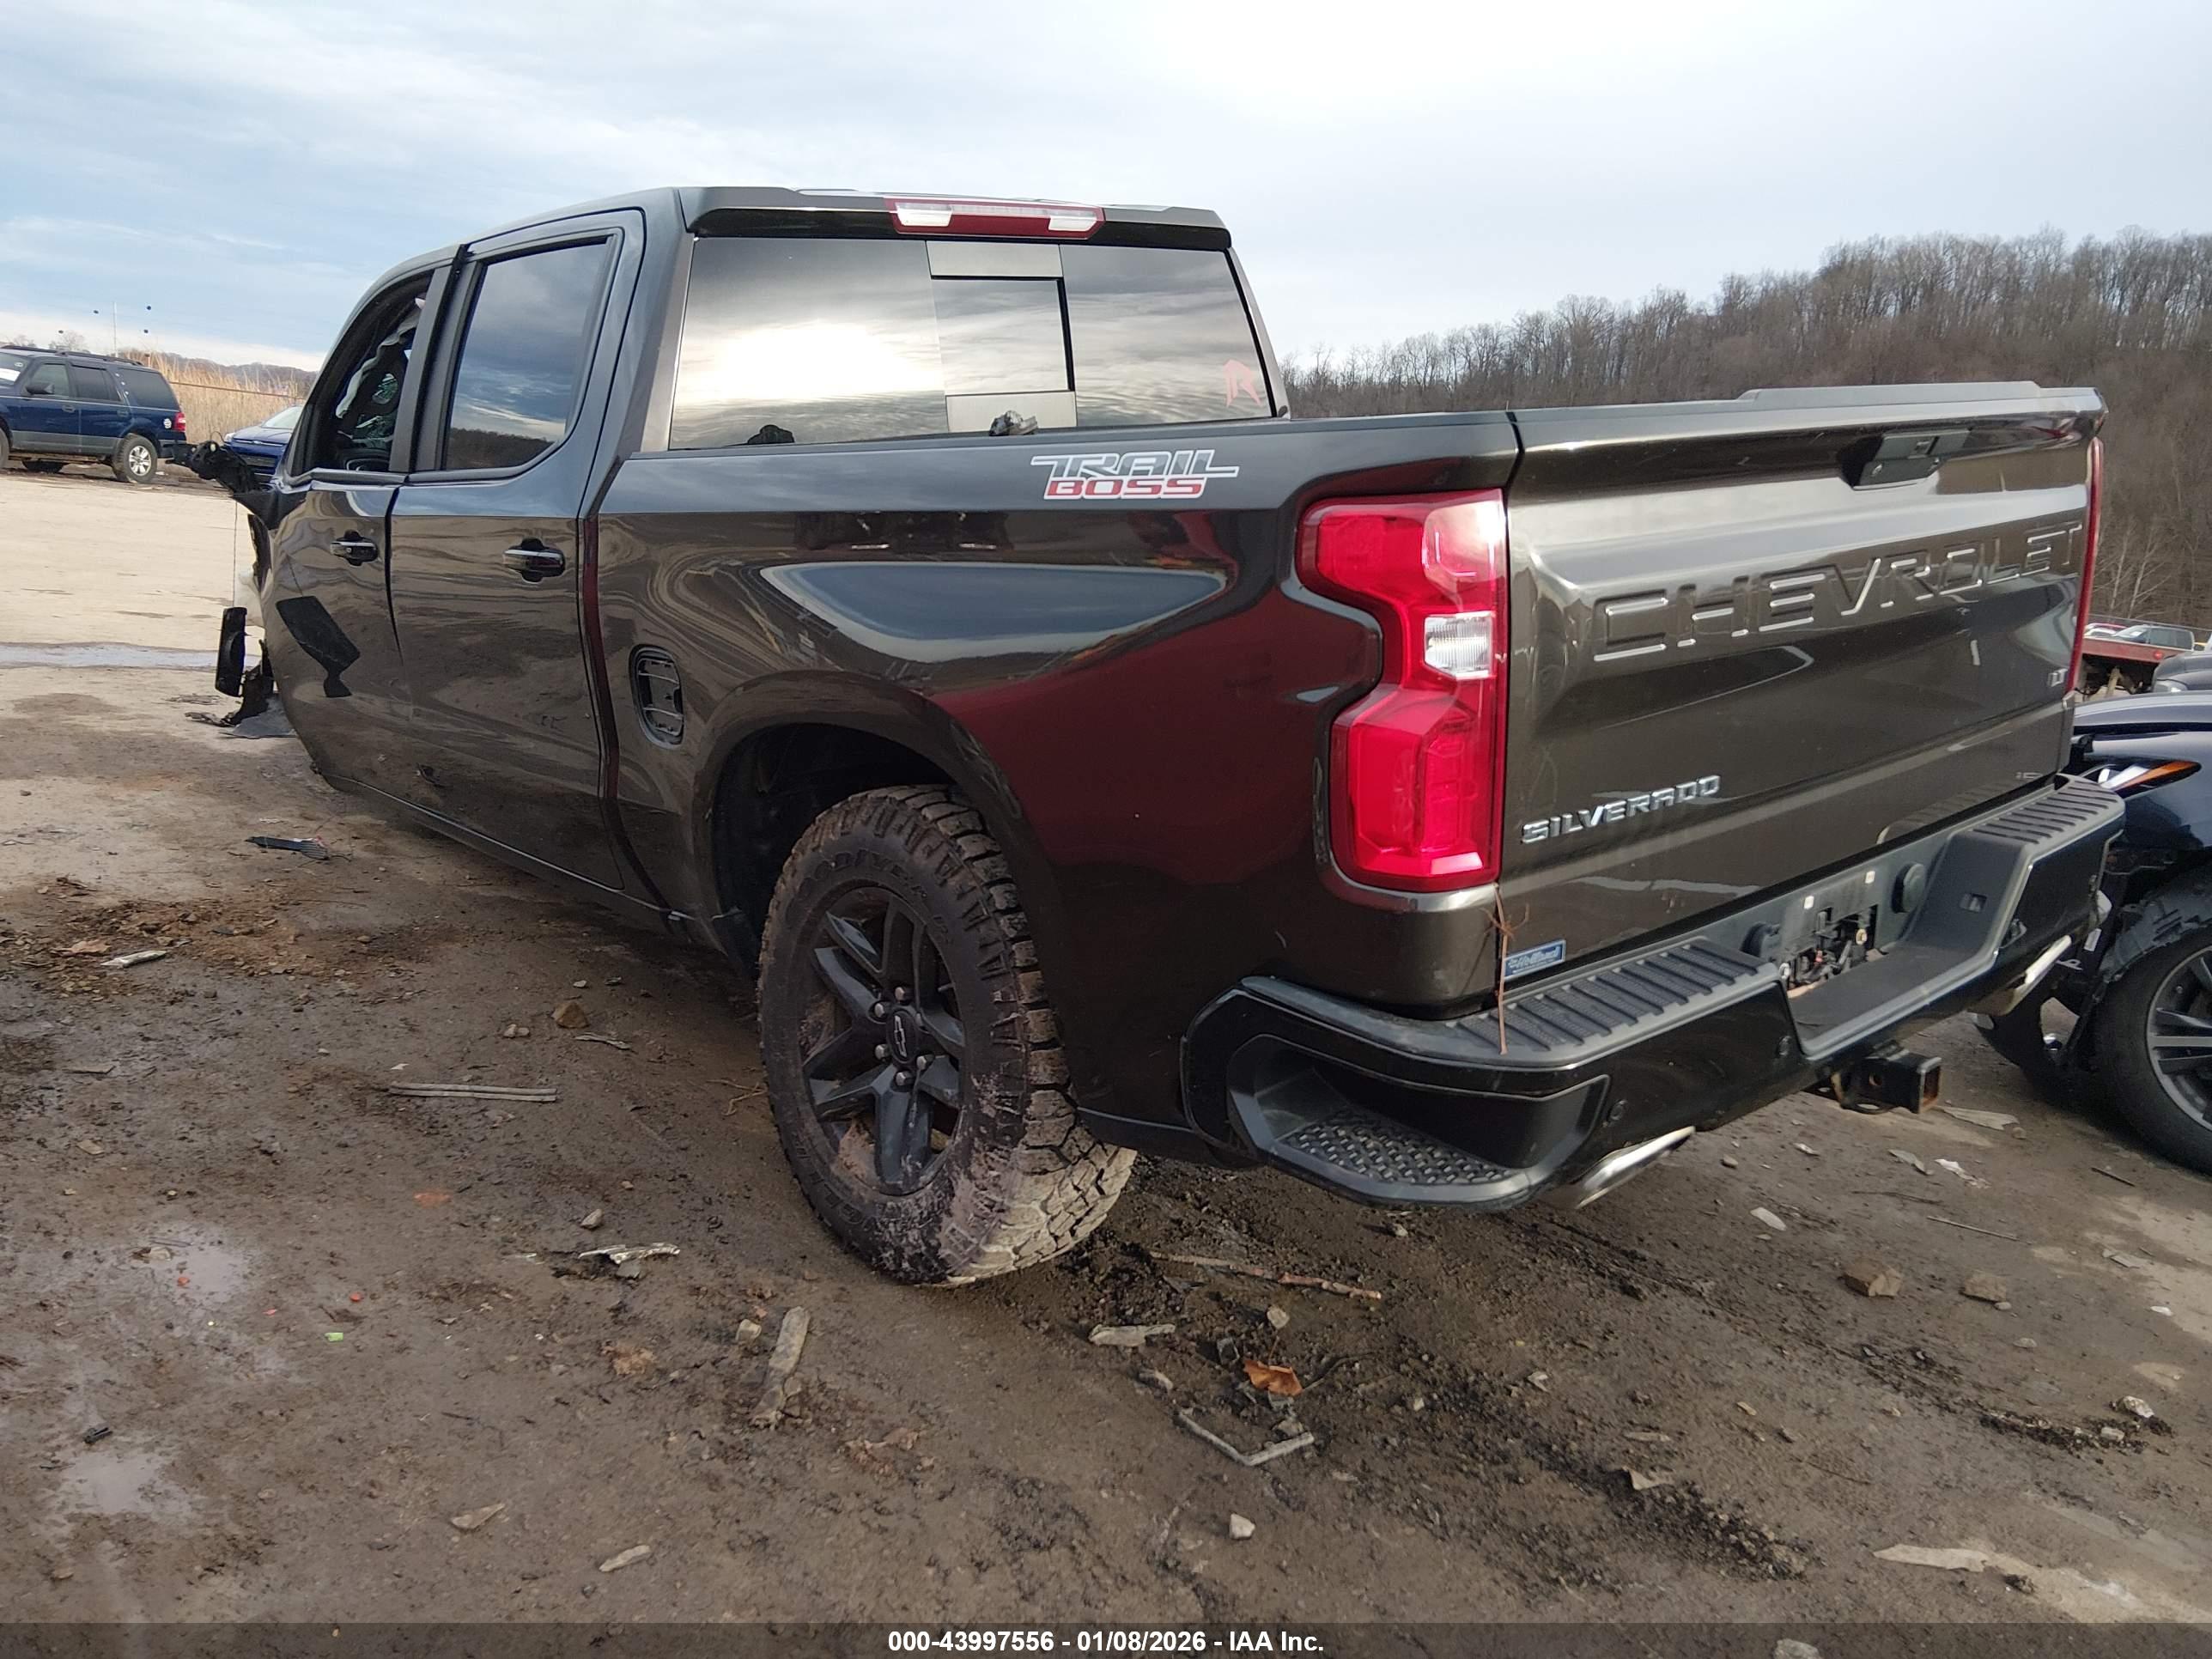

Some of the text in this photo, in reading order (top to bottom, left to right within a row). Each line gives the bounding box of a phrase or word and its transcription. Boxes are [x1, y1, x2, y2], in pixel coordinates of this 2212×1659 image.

[1030, 449, 1239, 478] TRAIL
[1044, 477, 1208, 500] BOSS
[1593, 522, 2083, 663] CHEVROLET
[1522, 775, 1721, 844] SILVERADO
